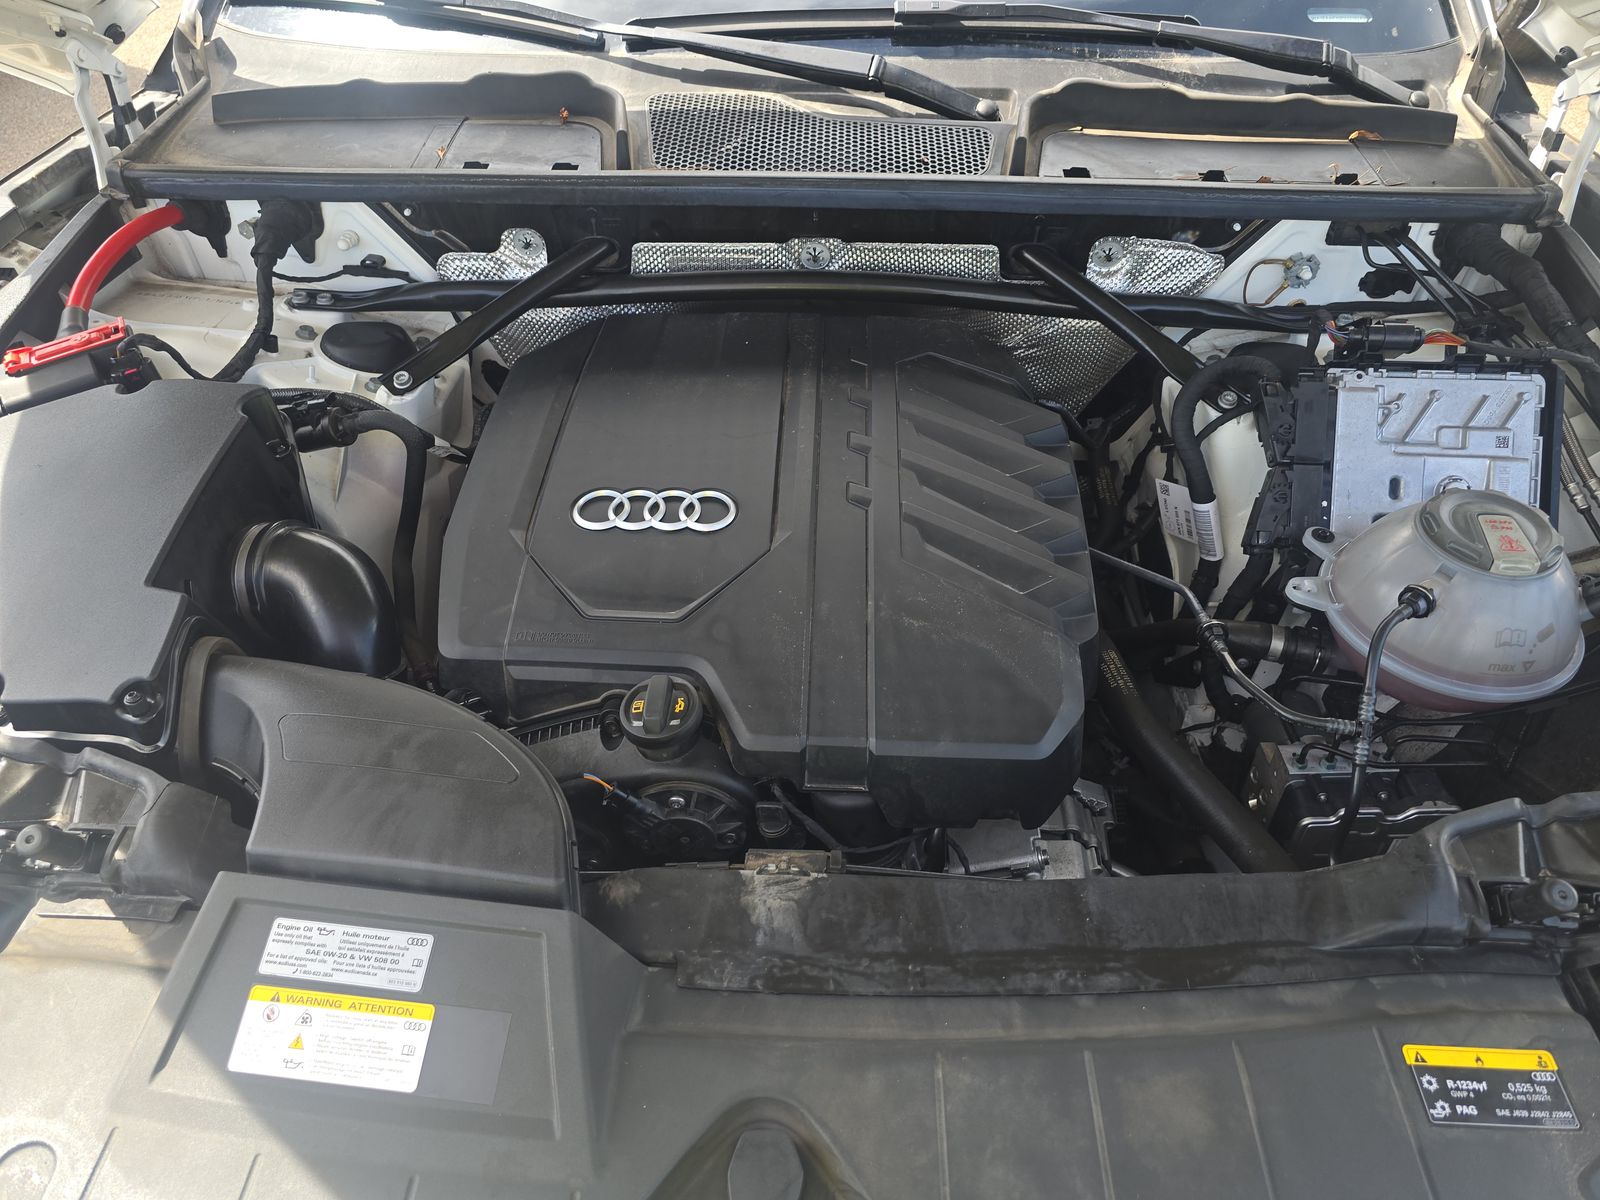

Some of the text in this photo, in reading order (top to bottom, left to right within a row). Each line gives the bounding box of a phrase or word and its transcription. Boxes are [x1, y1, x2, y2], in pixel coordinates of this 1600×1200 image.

[1487, 663, 1516, 673] max
[276, 922, 301, 932] Engine
[284, 933, 295, 941] only
[342, 930, 390, 942] Huile moteur
[271, 938, 294, 946] expressly
[294, 940, 316, 948] complies
[357, 941, 387, 950] uniquement
[293, 955, 317, 964] approved
[305, 948, 322, 956] SAE
[322, 950, 348, 959] 0W-20
[358, 954, 373, 962] VW
[373, 956, 389, 964] 508
[389, 958, 400, 966] 00
[285, 994, 415, 1017] WARNING ATTENTION
[1445, 1079, 1548, 1095] R-1234yf 0,525 kg
[1450, 1090, 1469, 1098] GWP
[1455, 1104, 1479, 1116] PAG
[1495, 1108, 1512, 1117] SAE
